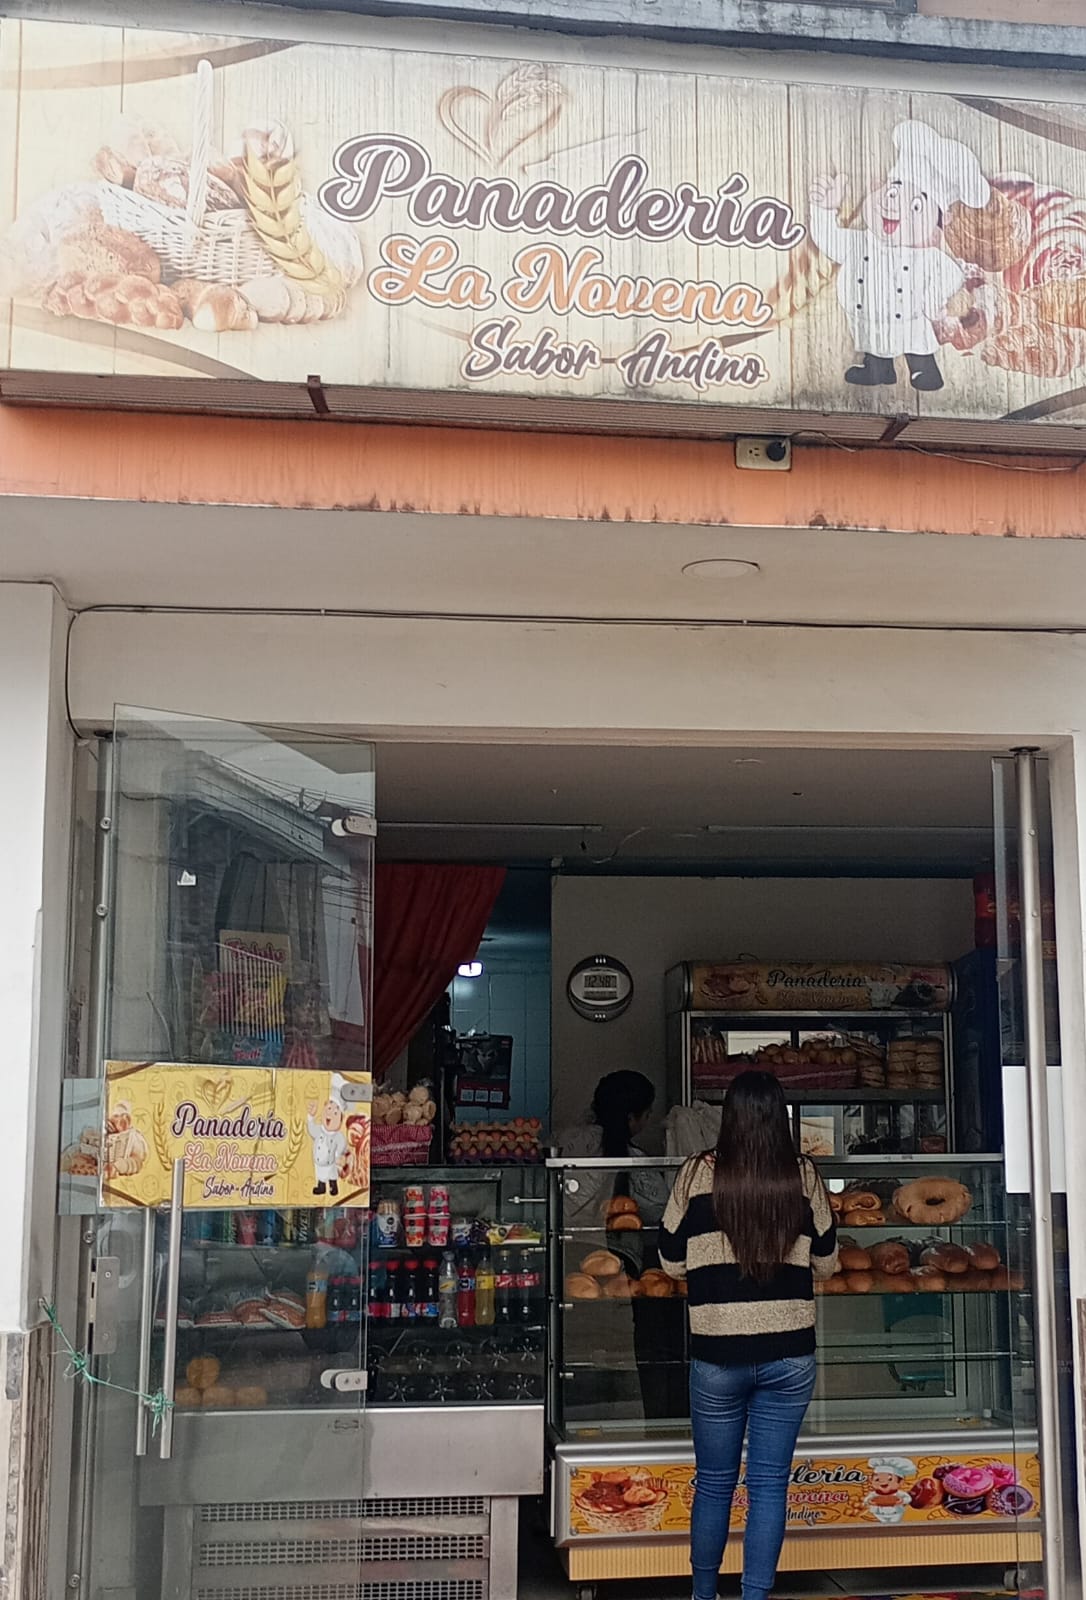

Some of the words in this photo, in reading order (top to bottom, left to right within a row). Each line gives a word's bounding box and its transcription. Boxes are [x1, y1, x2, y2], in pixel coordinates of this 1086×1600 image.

[320, 135, 803, 247] Panadería
[371, 236, 492, 305] La
[504, 244, 771, 324] Novena
[172, 1101, 286, 1138] Panadería
[184, 1142, 210, 1171] La
